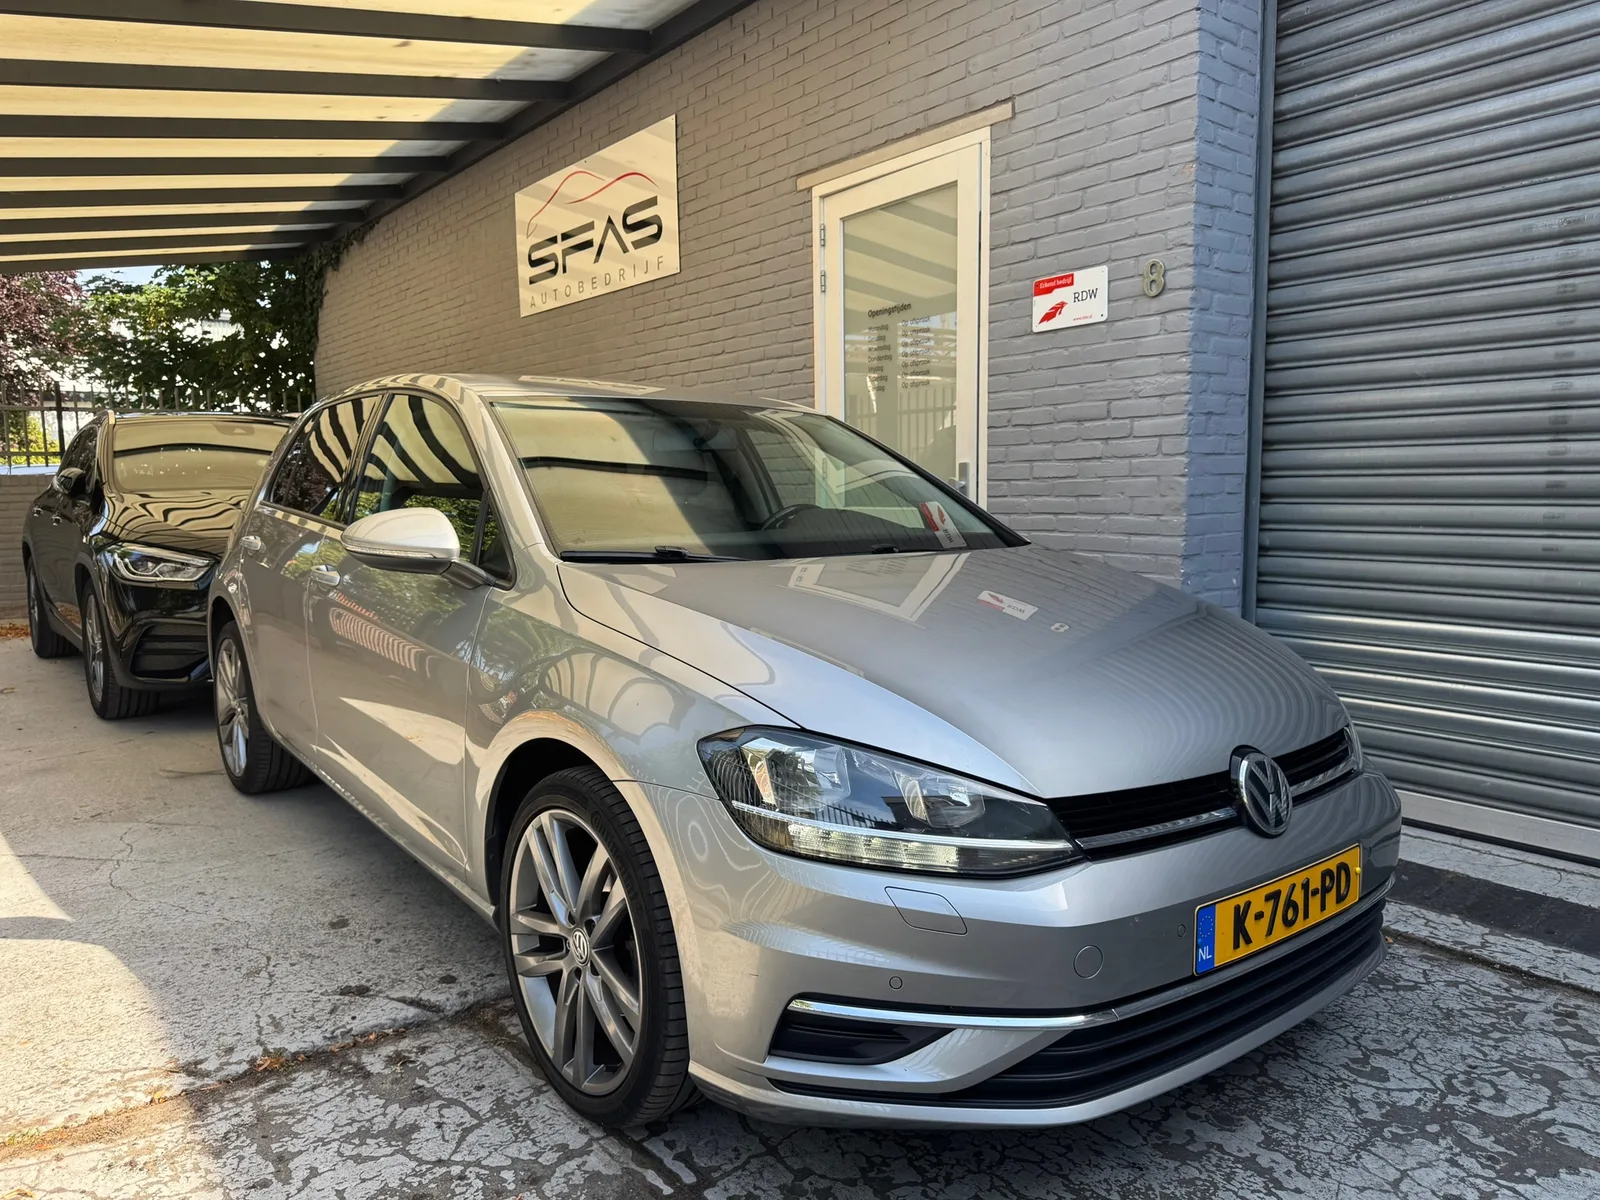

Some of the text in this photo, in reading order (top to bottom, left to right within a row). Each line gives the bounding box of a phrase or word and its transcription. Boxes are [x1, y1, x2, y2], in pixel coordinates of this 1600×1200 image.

[527, 195, 663, 285] SFAS
[530, 256, 664, 309] AUTOBEDRIJF
[1073, 288, 1098, 303] RDW
[1143, 259, 1165, 298] 8
[868, 303, 911, 318] Openingstijden
[1232, 861, 1351, 950] K-761-PD
[1198, 946, 1213, 962] NL
